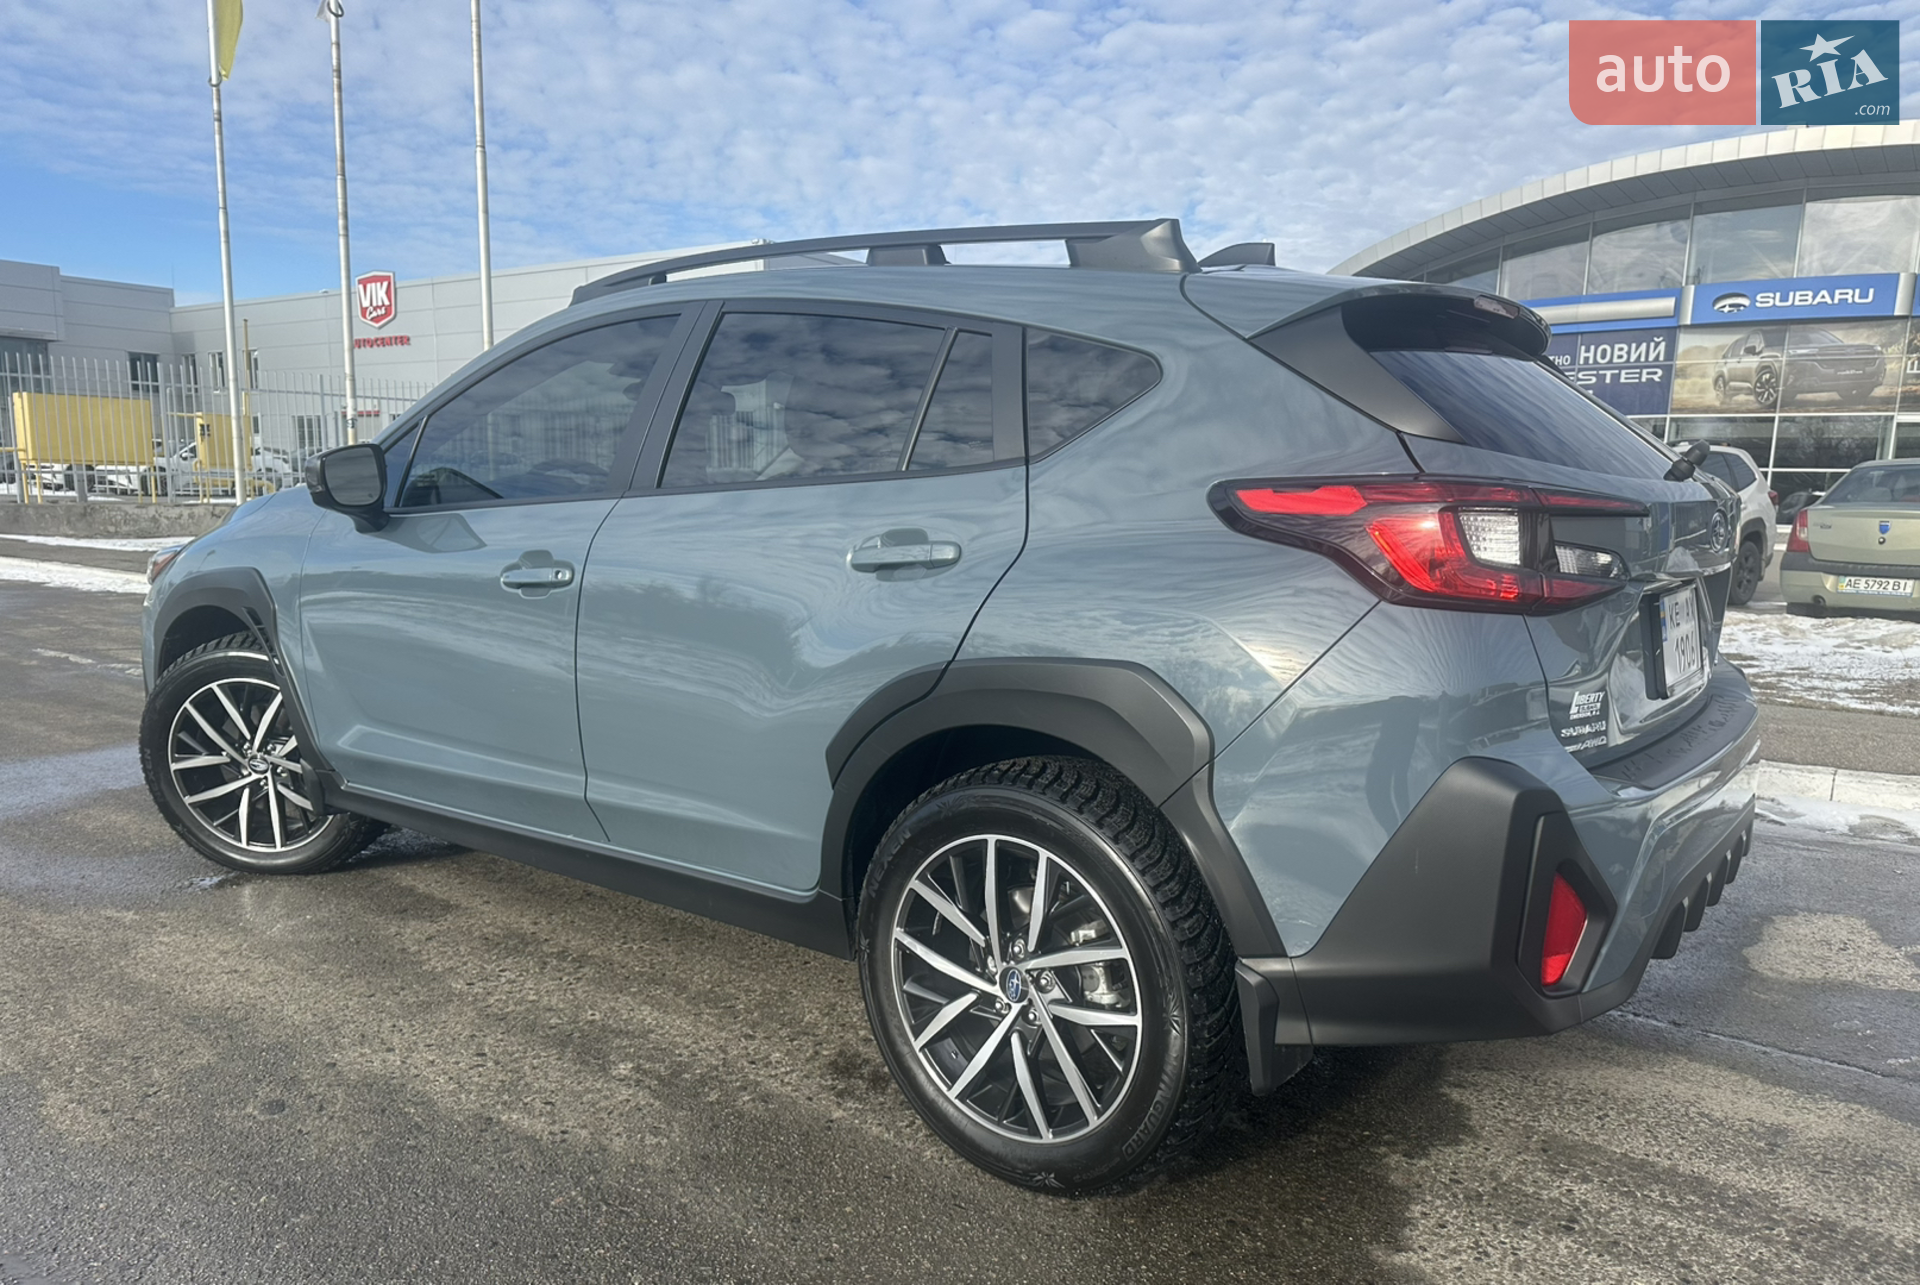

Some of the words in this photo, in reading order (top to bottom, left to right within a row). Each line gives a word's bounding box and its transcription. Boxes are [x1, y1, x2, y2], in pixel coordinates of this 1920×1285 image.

[358, 280, 390, 308] VIK
[1755, 288, 1875, 308] SUBARU
[354, 335, 410, 349] UTOCENTER
[1579, 337, 1666, 365] НОВИЙ
[1845, 578, 1861, 589] AE
[1863, 579, 1890, 590] 5792
[1668, 601, 1681, 629] KE
[868, 828, 912, 898] NEXEN
